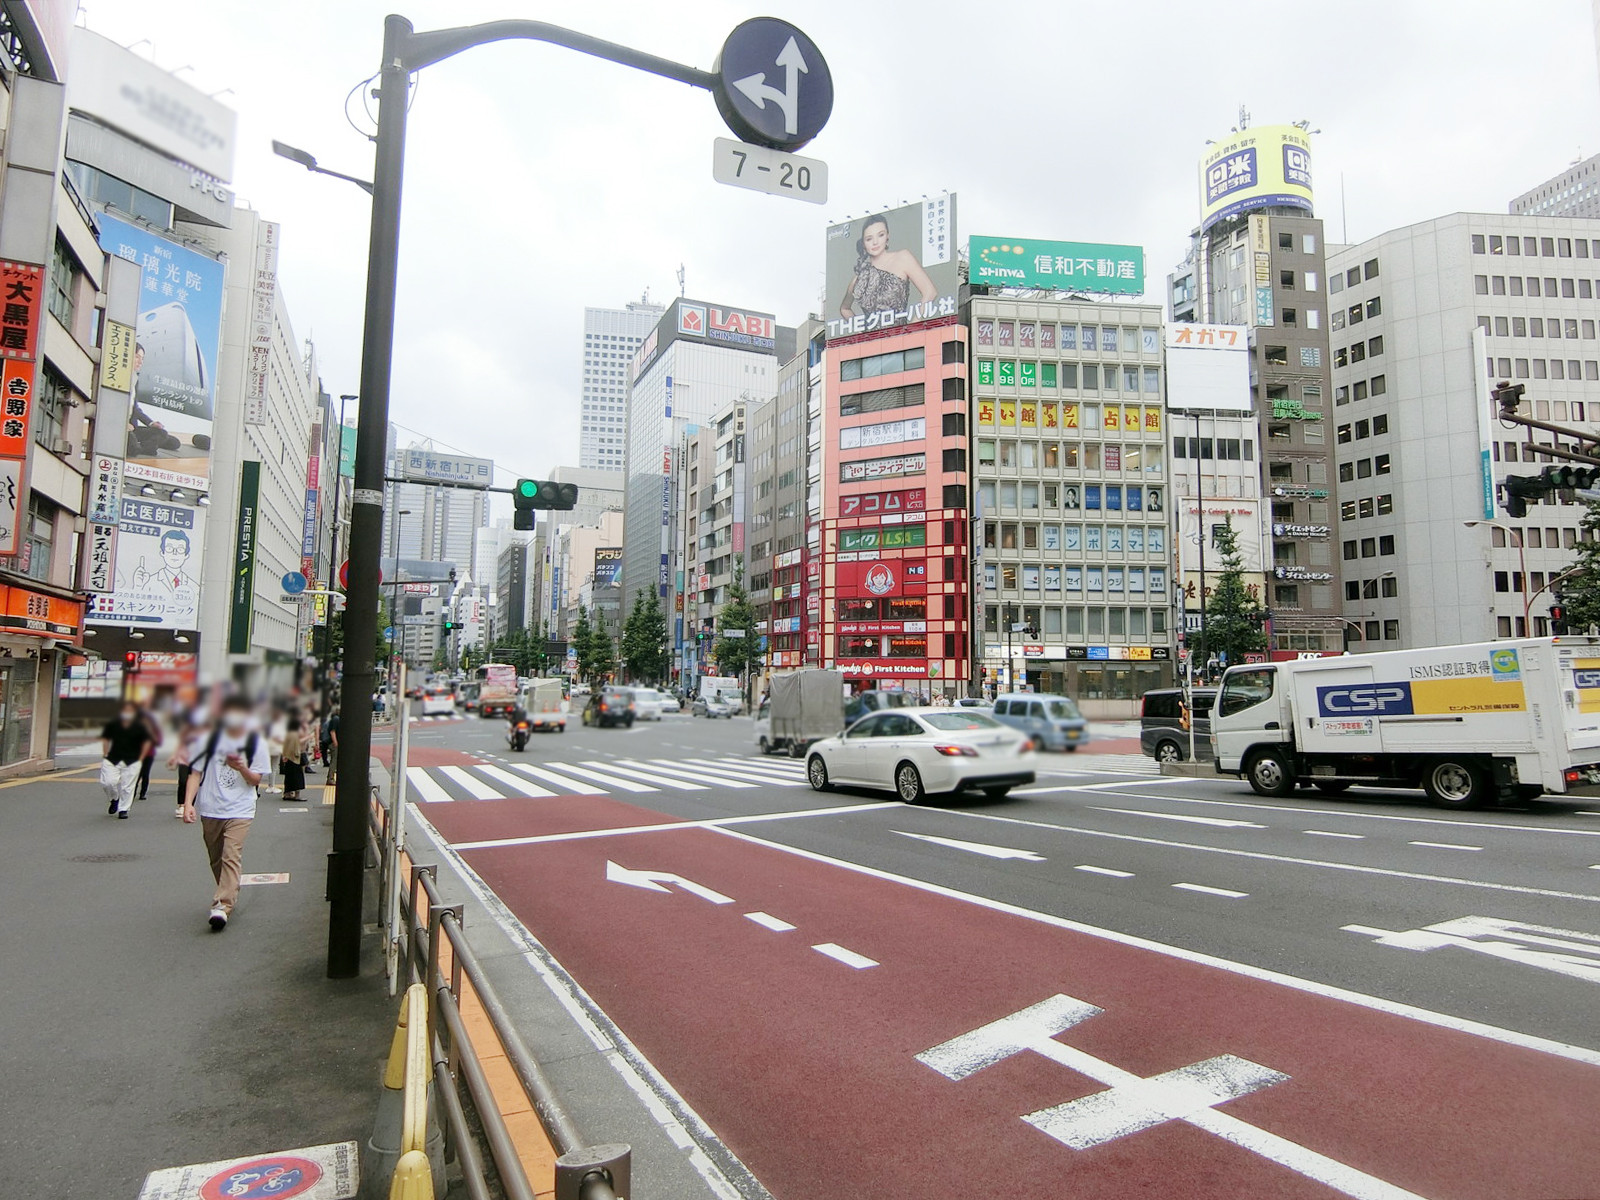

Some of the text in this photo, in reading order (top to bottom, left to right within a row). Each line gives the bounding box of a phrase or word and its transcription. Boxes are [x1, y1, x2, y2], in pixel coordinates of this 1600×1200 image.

[189, 174, 228, 202] FPG
[1243, 198, 1267, 207] SERVICE
[3, 269, 38, 281] チケット
[1033, 254, 1136, 280] 信和不動産
[0, 281, 33, 351] 大黒屋
[709, 308, 773, 339] LABI
[827, 296, 955, 337] THEグローバル社
[709, 329, 751, 345] SHINJUKU
[1175, 327, 1238, 346] オガワ
[4, 378, 29, 438] 吉野家
[979, 405, 1035, 422] 占い館
[1103, 409, 1159, 427] 占い館
[862, 423, 903, 437] 新宿駅前
[410, 457, 488, 477] 西新宿1丁目
[664, 452, 672, 474] LABI
[125, 465, 204, 488] より2本目右折 徒歩1分
[425, 470, 469, 481] Nishishinjuku
[661, 476, 670, 508] SHINJUKU
[909, 490, 922, 500] 6F
[306, 499, 315, 520] JAPAN
[844, 493, 900, 514] アコム
[123, 501, 192, 527] は医師に。
[905, 513, 924, 521] アコム
[845, 531, 912, 548] レイクALSA
[91, 537, 110, 590] 元祖寿司
[1285, 572, 1334, 580] ダイエットセンター
[117, 601, 194, 616] スキンクリニック
[836, 662, 861, 676] Wendy's
[874, 665, 925, 673] First Kitchen
[1409, 660, 1491, 679] ISMS認証取得
[1323, 687, 1405, 712] CSP
